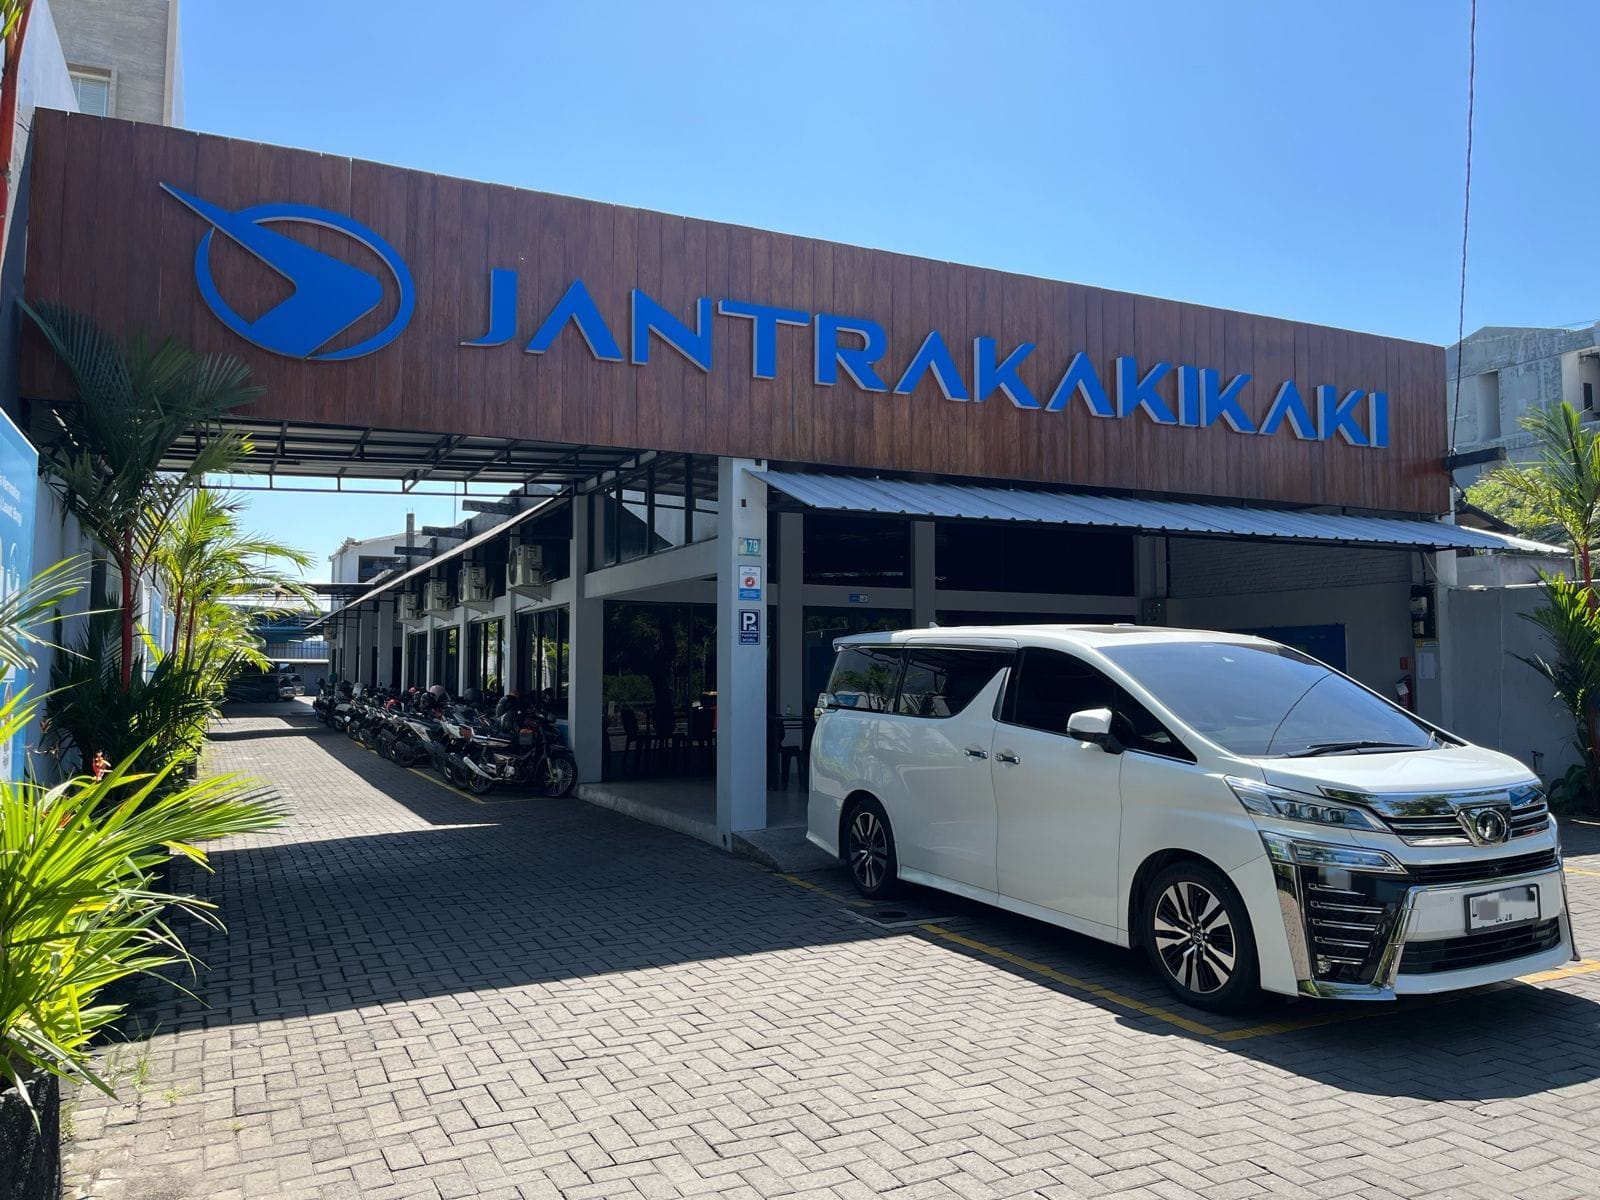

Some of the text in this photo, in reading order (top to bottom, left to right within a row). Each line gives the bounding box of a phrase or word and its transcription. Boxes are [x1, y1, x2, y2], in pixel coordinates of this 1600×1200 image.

[460, 269, 1389, 449] JANTRAKAKIKAKI
[743, 539, 759, 553] 179
[743, 612, 756, 631] P
